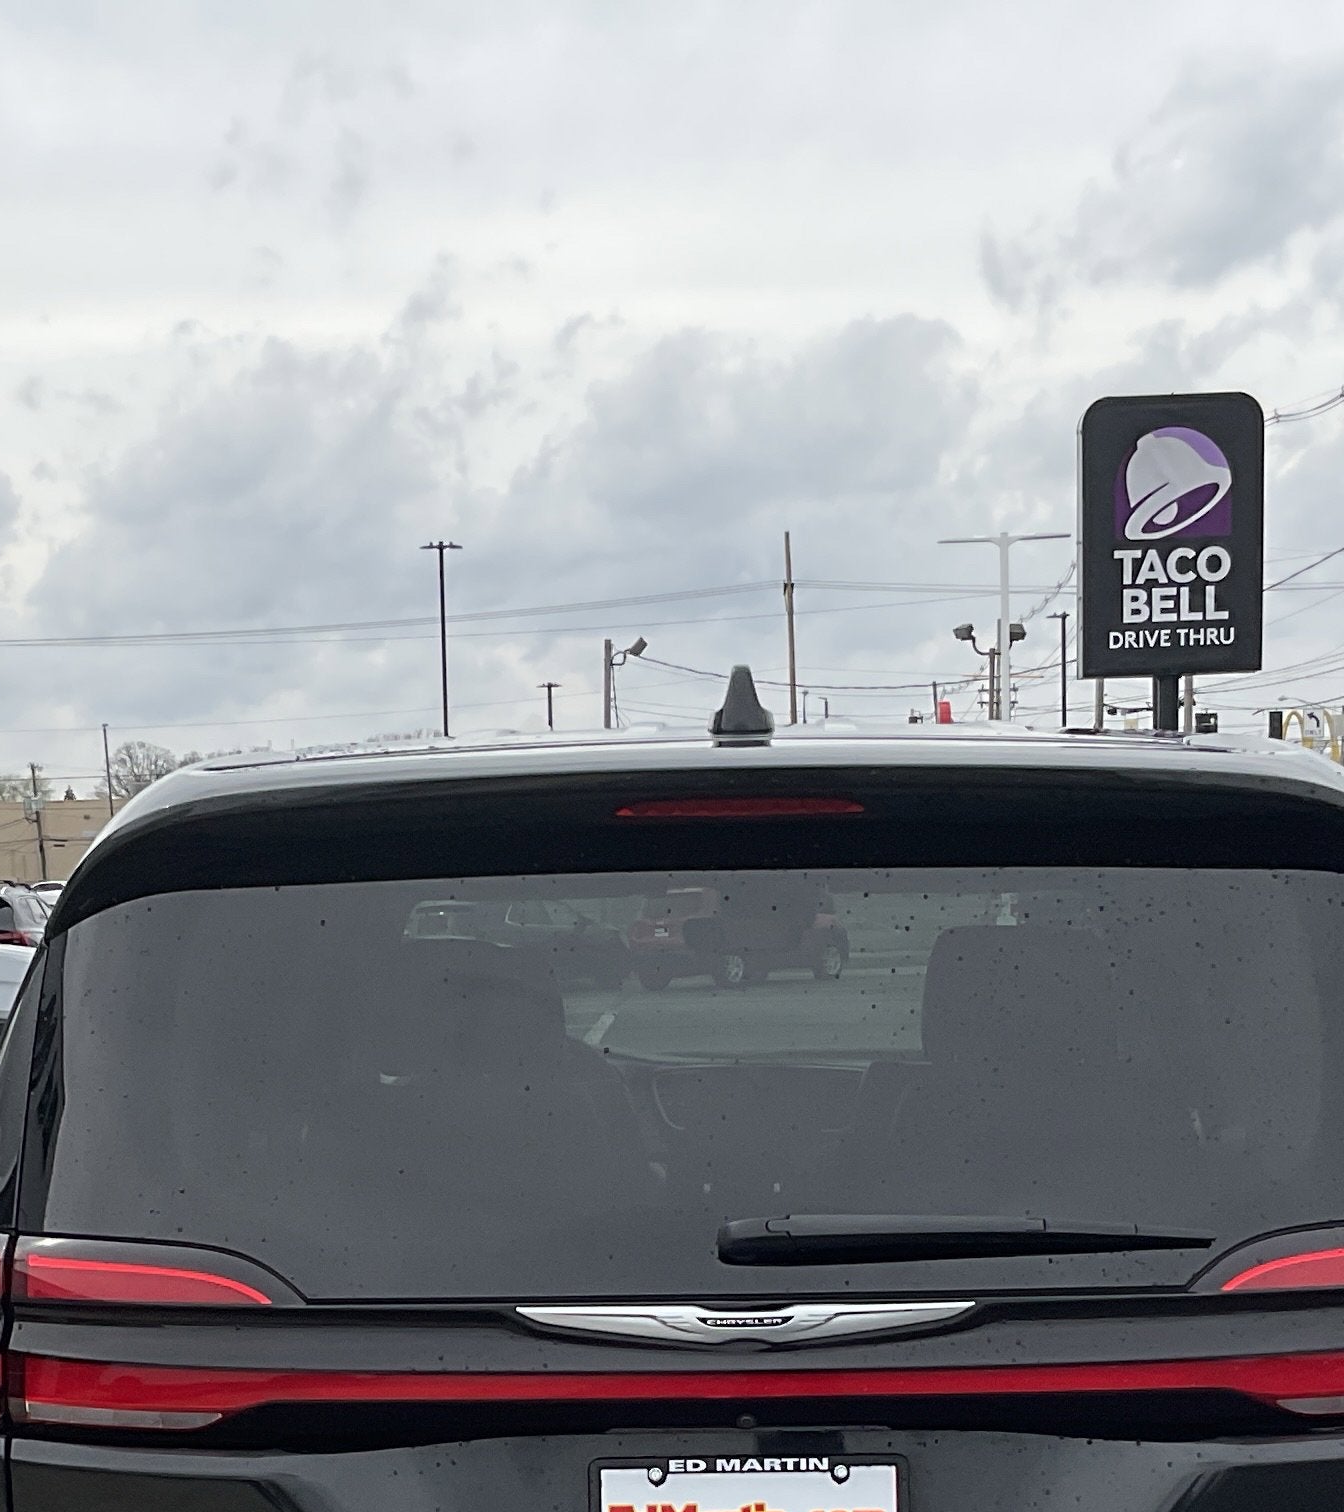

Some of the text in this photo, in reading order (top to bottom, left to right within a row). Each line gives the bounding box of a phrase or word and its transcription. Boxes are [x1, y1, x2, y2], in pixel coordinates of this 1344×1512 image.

[1113, 545, 1232, 585] TACO
[1122, 585, 1230, 624] BELL
[1109, 626, 1235, 650] DRIVE THRU
[706, 1317, 783, 1326] CHRYSLER
[668, 1457, 829, 1473] ED MARTIN
